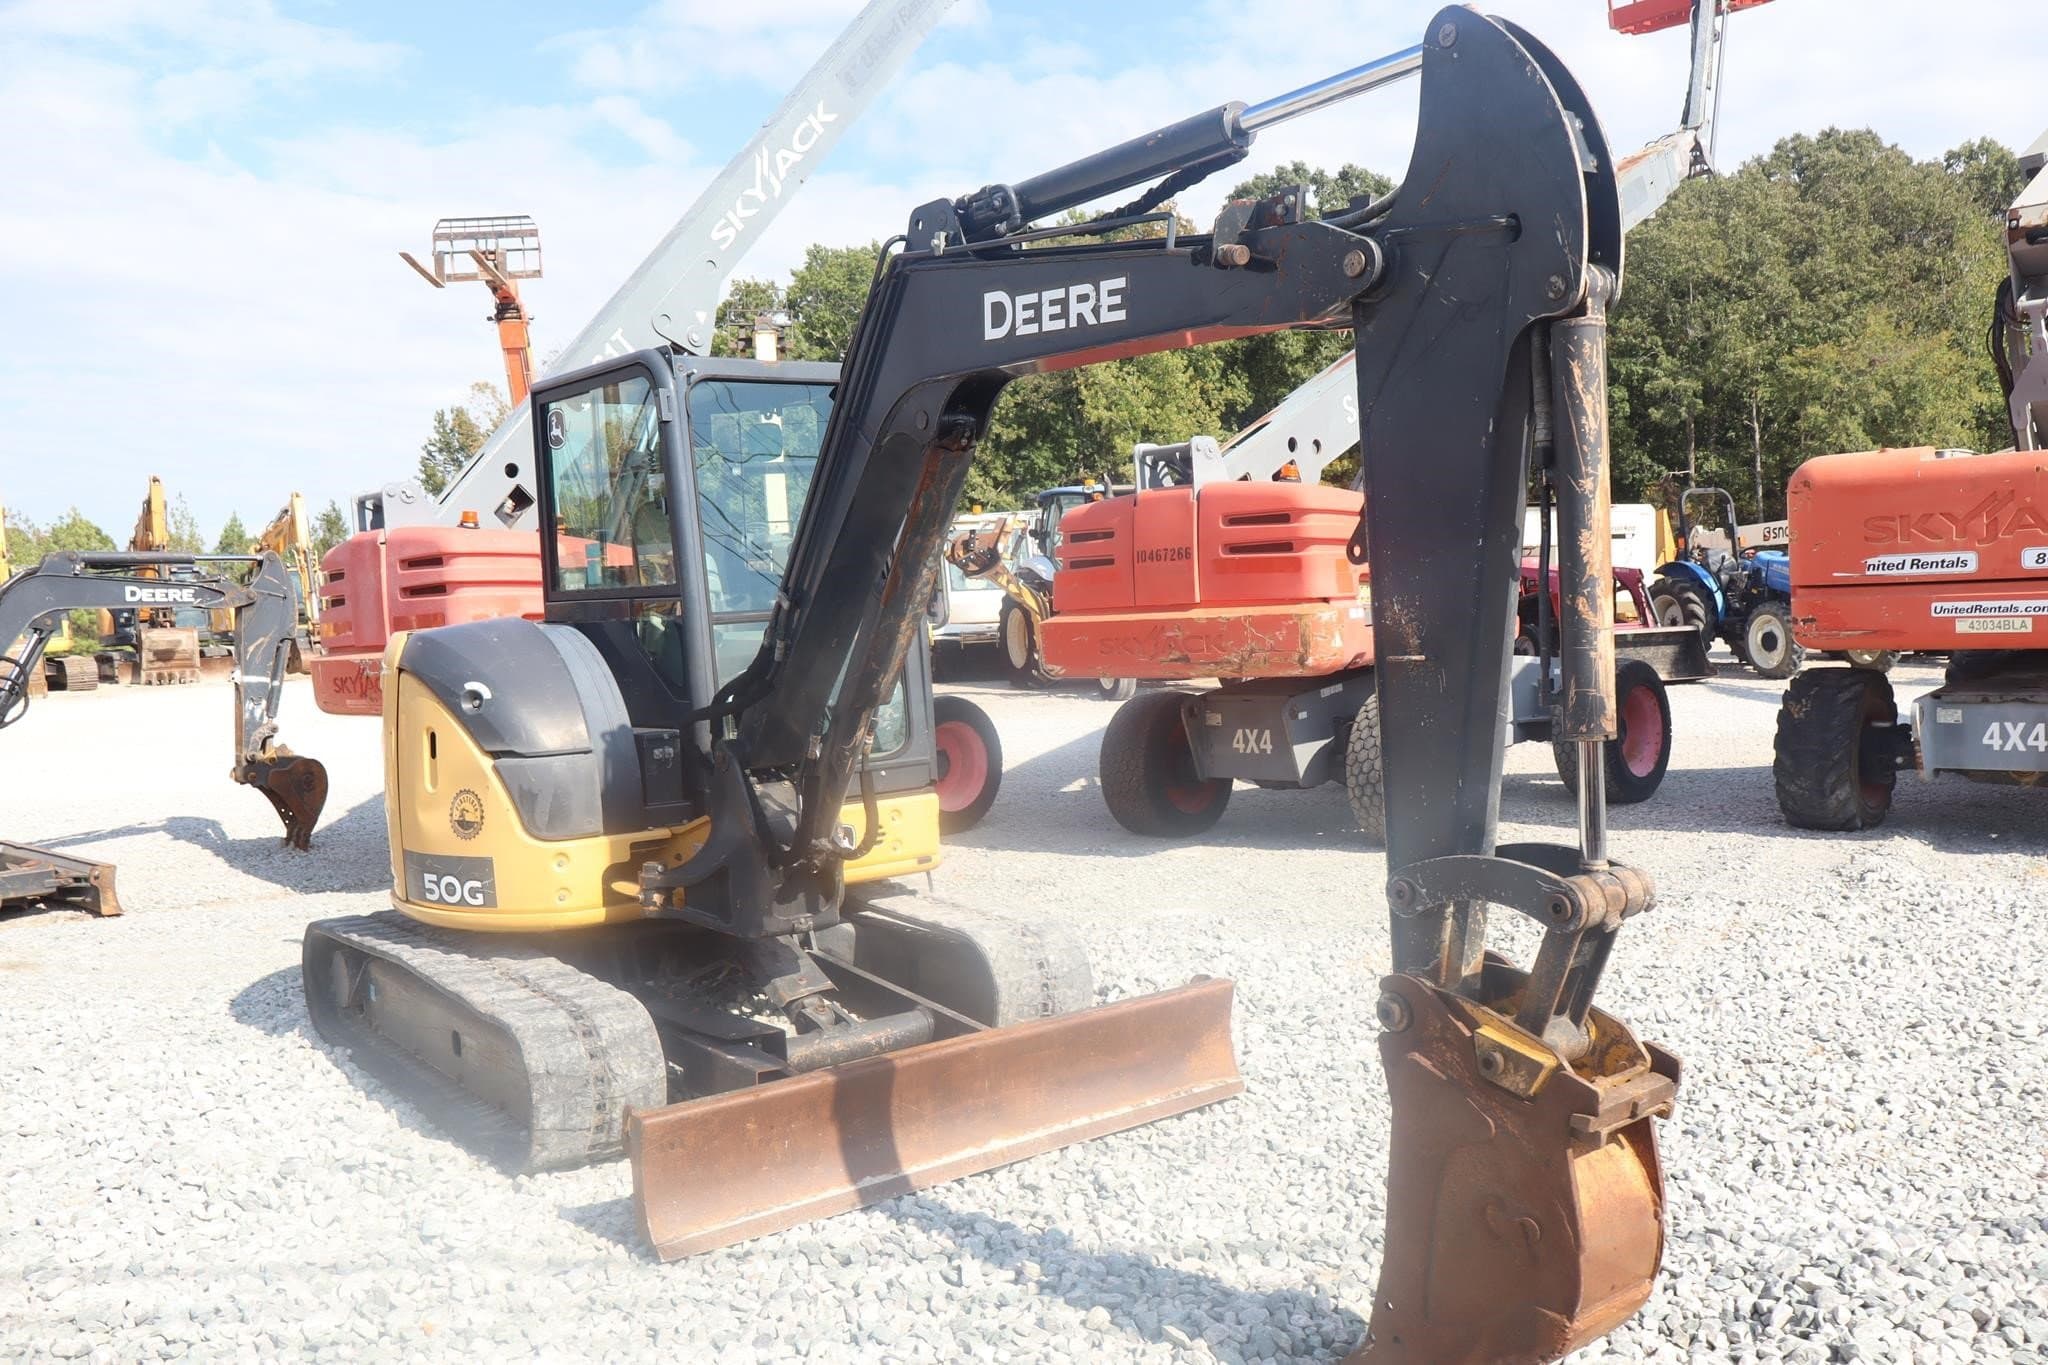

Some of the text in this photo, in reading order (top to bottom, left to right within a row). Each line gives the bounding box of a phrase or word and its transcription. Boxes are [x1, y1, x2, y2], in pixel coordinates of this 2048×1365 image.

[710, 100, 839, 251] SKYJACK
[983, 276, 1127, 341] DEERE
[1865, 556, 1969, 572] nited Rentals
[125, 585, 195, 602] DEERE
[1968, 619, 2028, 630] 43034BLA
[1232, 728, 1273, 754] 4X4
[1982, 721, 2048, 752] 4X4
[423, 873, 484, 906] 50G
